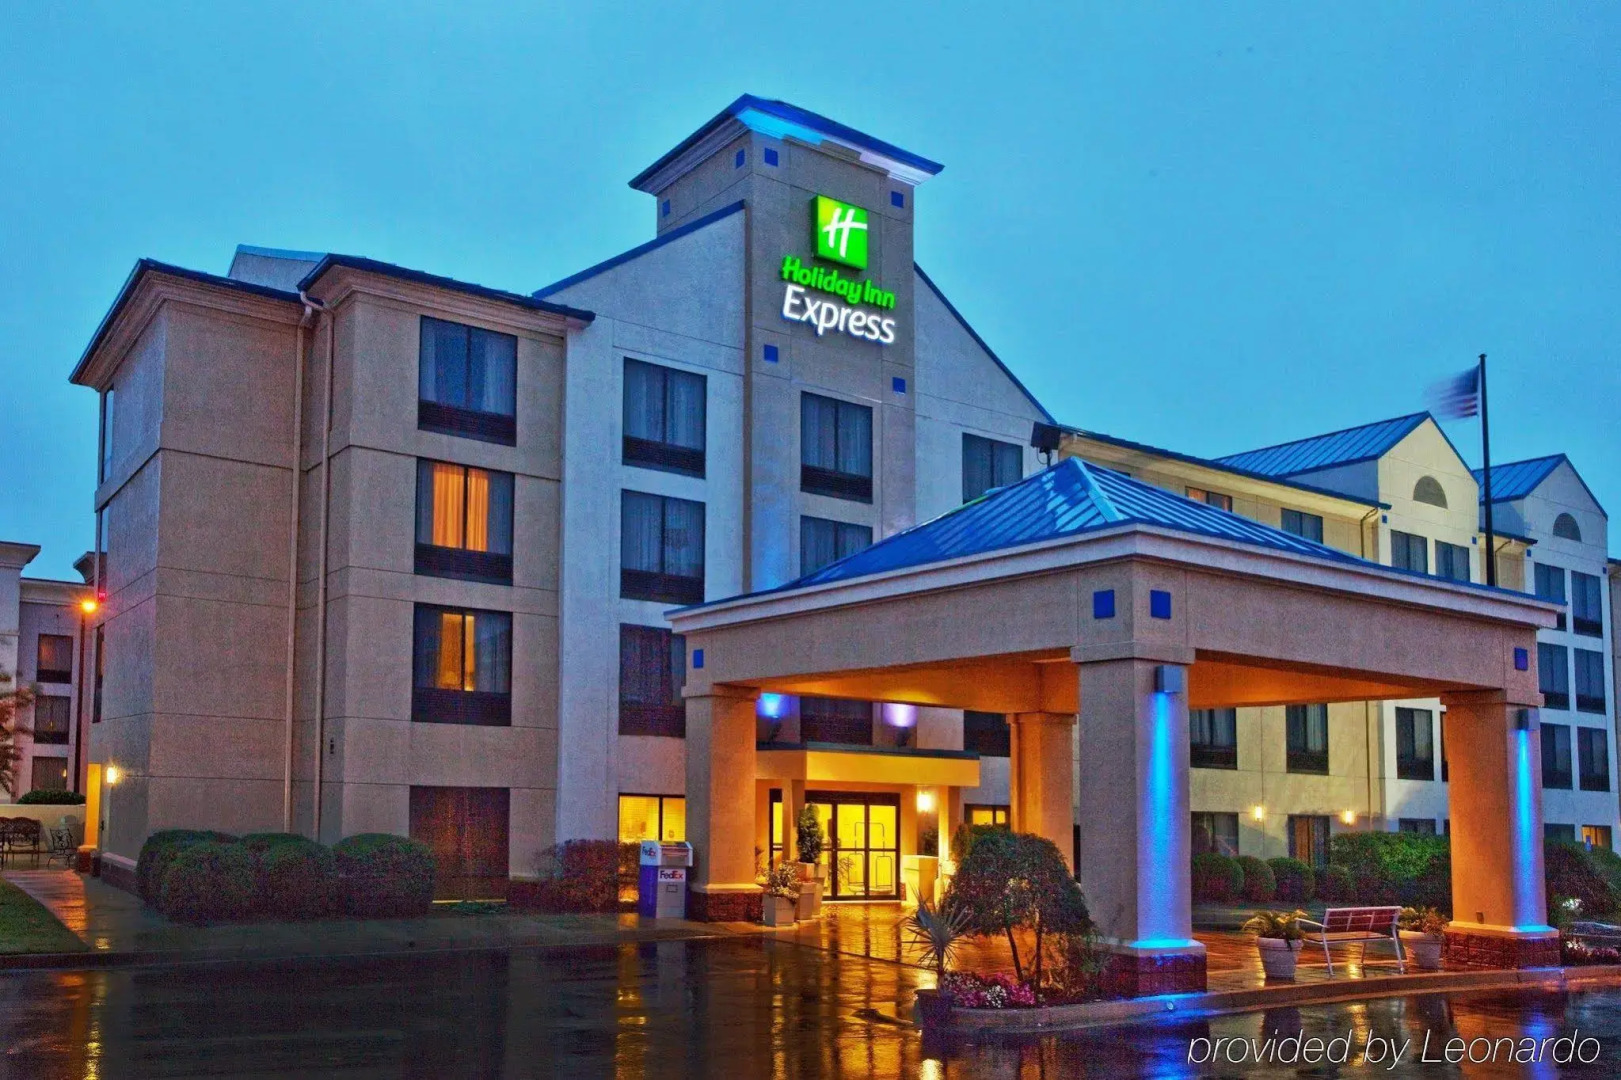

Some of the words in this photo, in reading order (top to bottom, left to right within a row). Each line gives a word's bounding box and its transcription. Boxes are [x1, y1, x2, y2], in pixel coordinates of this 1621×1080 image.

[782, 255, 862, 304] Holiday
[864, 279, 896, 309] Inn
[782, 284, 896, 344] Express
[660, 870, 683, 880] FedEx
